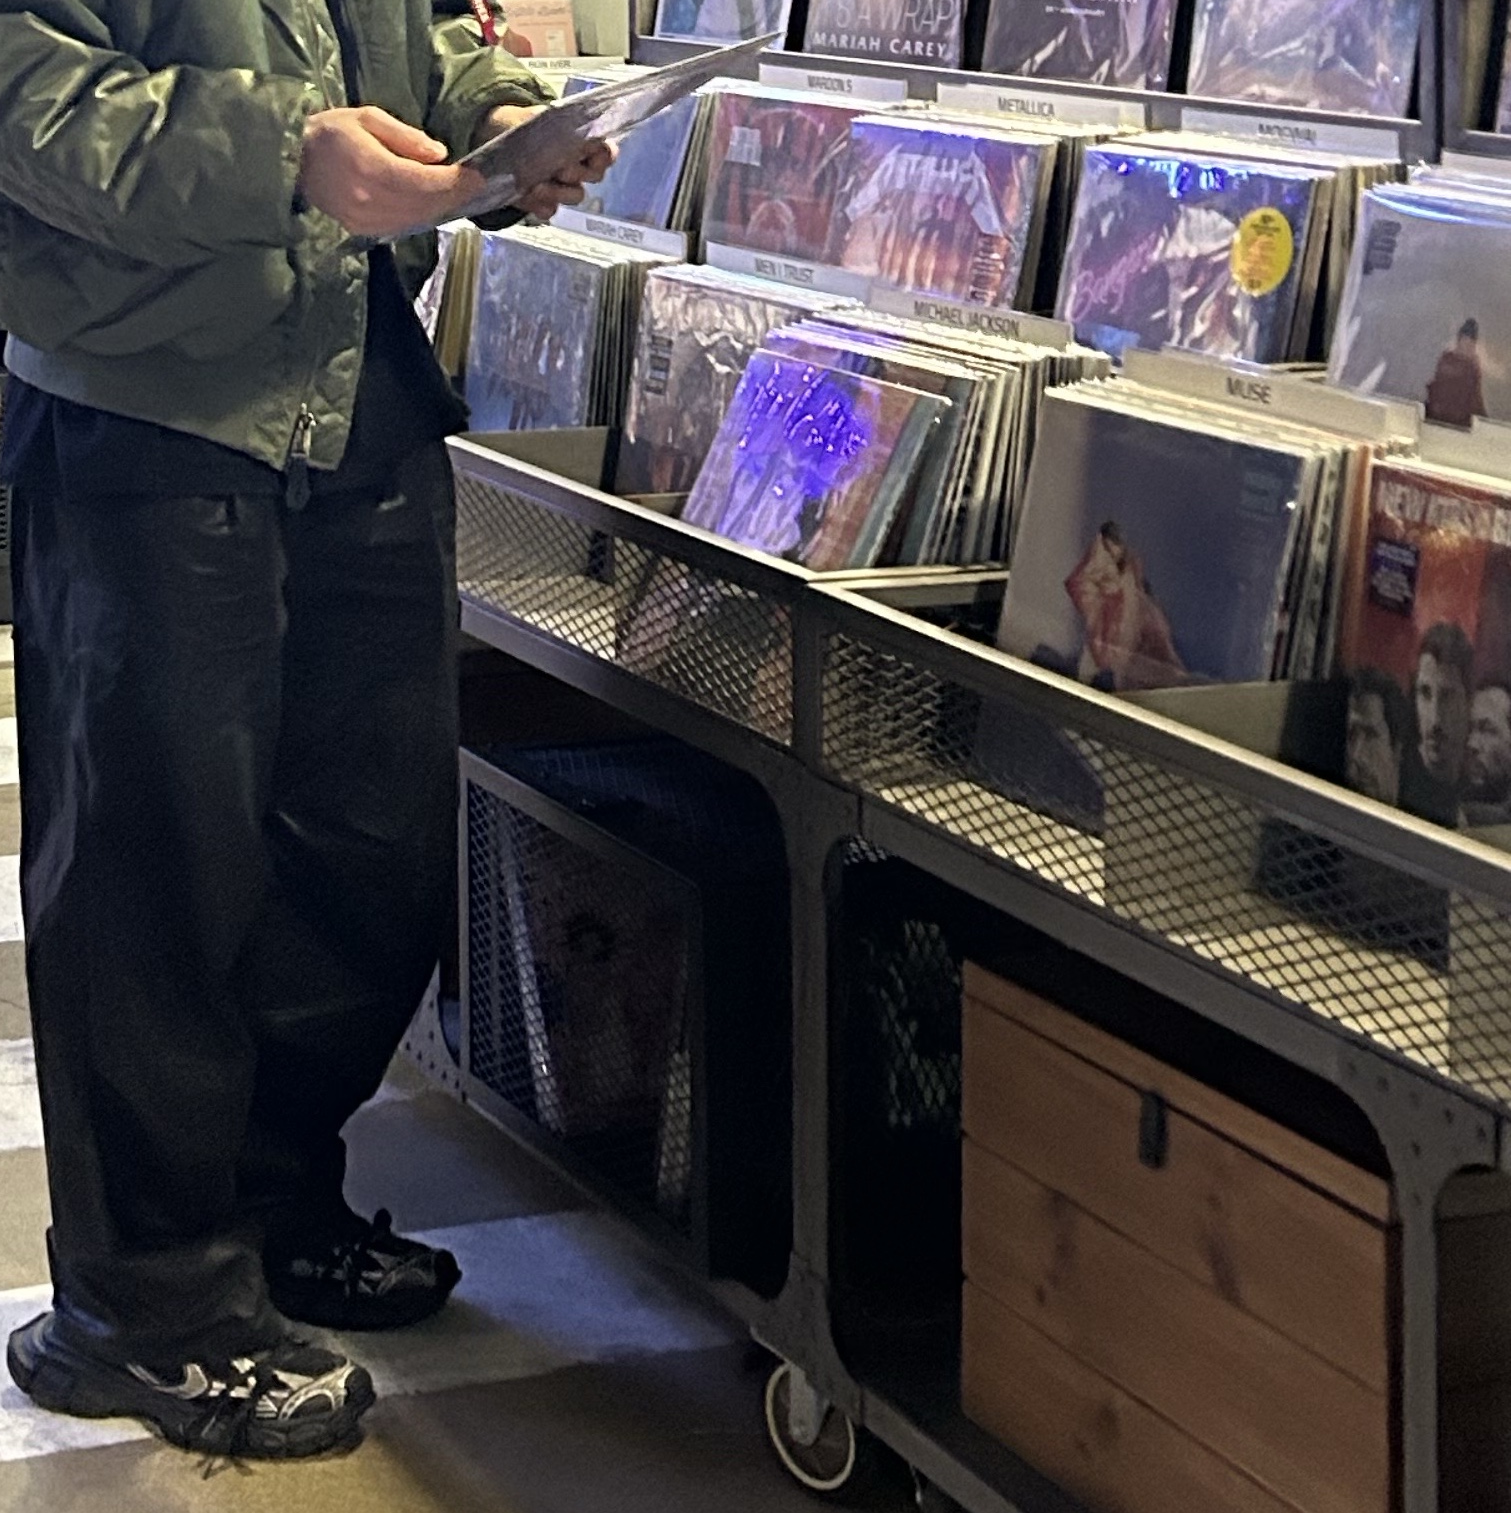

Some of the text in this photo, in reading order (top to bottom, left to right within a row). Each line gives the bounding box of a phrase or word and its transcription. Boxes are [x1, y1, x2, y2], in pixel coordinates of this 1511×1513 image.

[812, 31, 947, 59] MARIAH CAREY
[998, 96, 1056, 117] METALLICA
[914, 300, 1020, 338] MICHAEL JACKSON
[1226, 376, 1272, 405] MUSE
